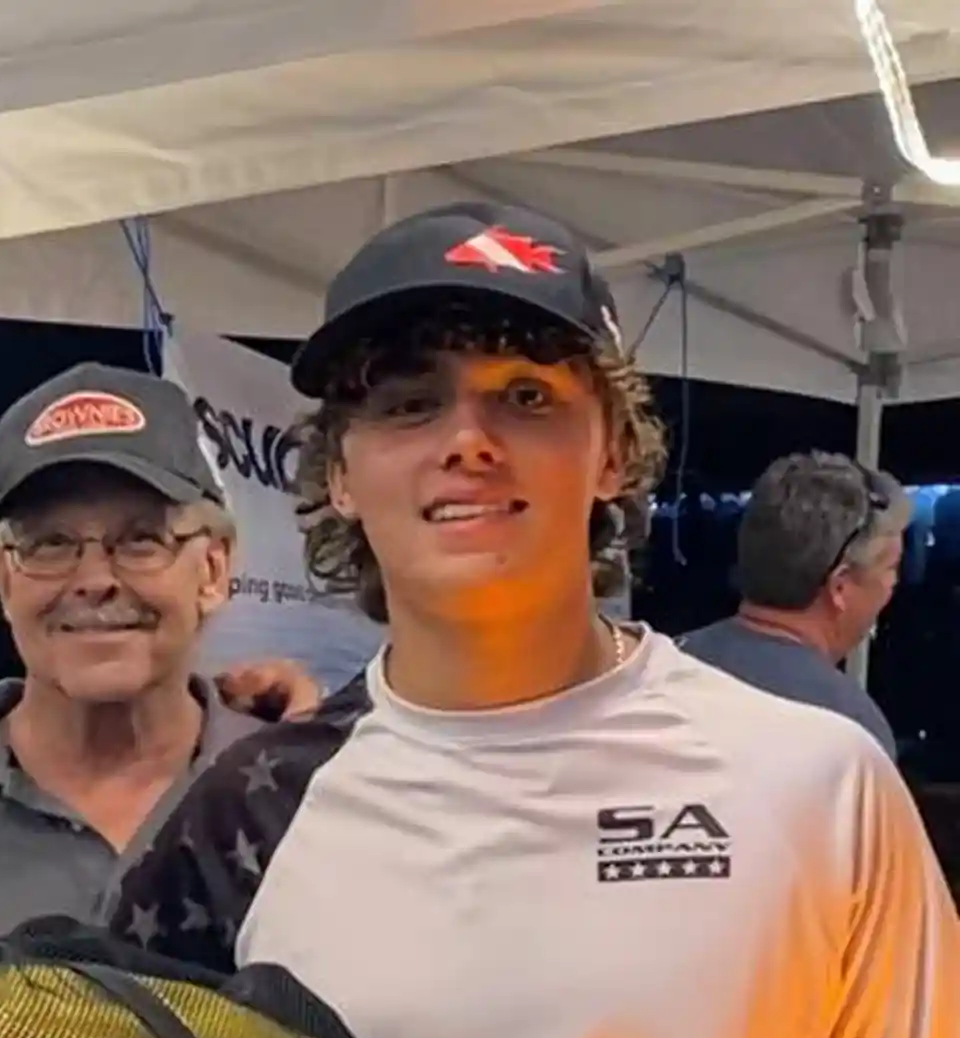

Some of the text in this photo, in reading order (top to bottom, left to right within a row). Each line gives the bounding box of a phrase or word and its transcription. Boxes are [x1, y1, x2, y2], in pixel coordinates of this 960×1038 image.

[228, 575, 270, 604] ping
[597, 803, 730, 843] SA
[597, 842, 731, 857] COMPANY
